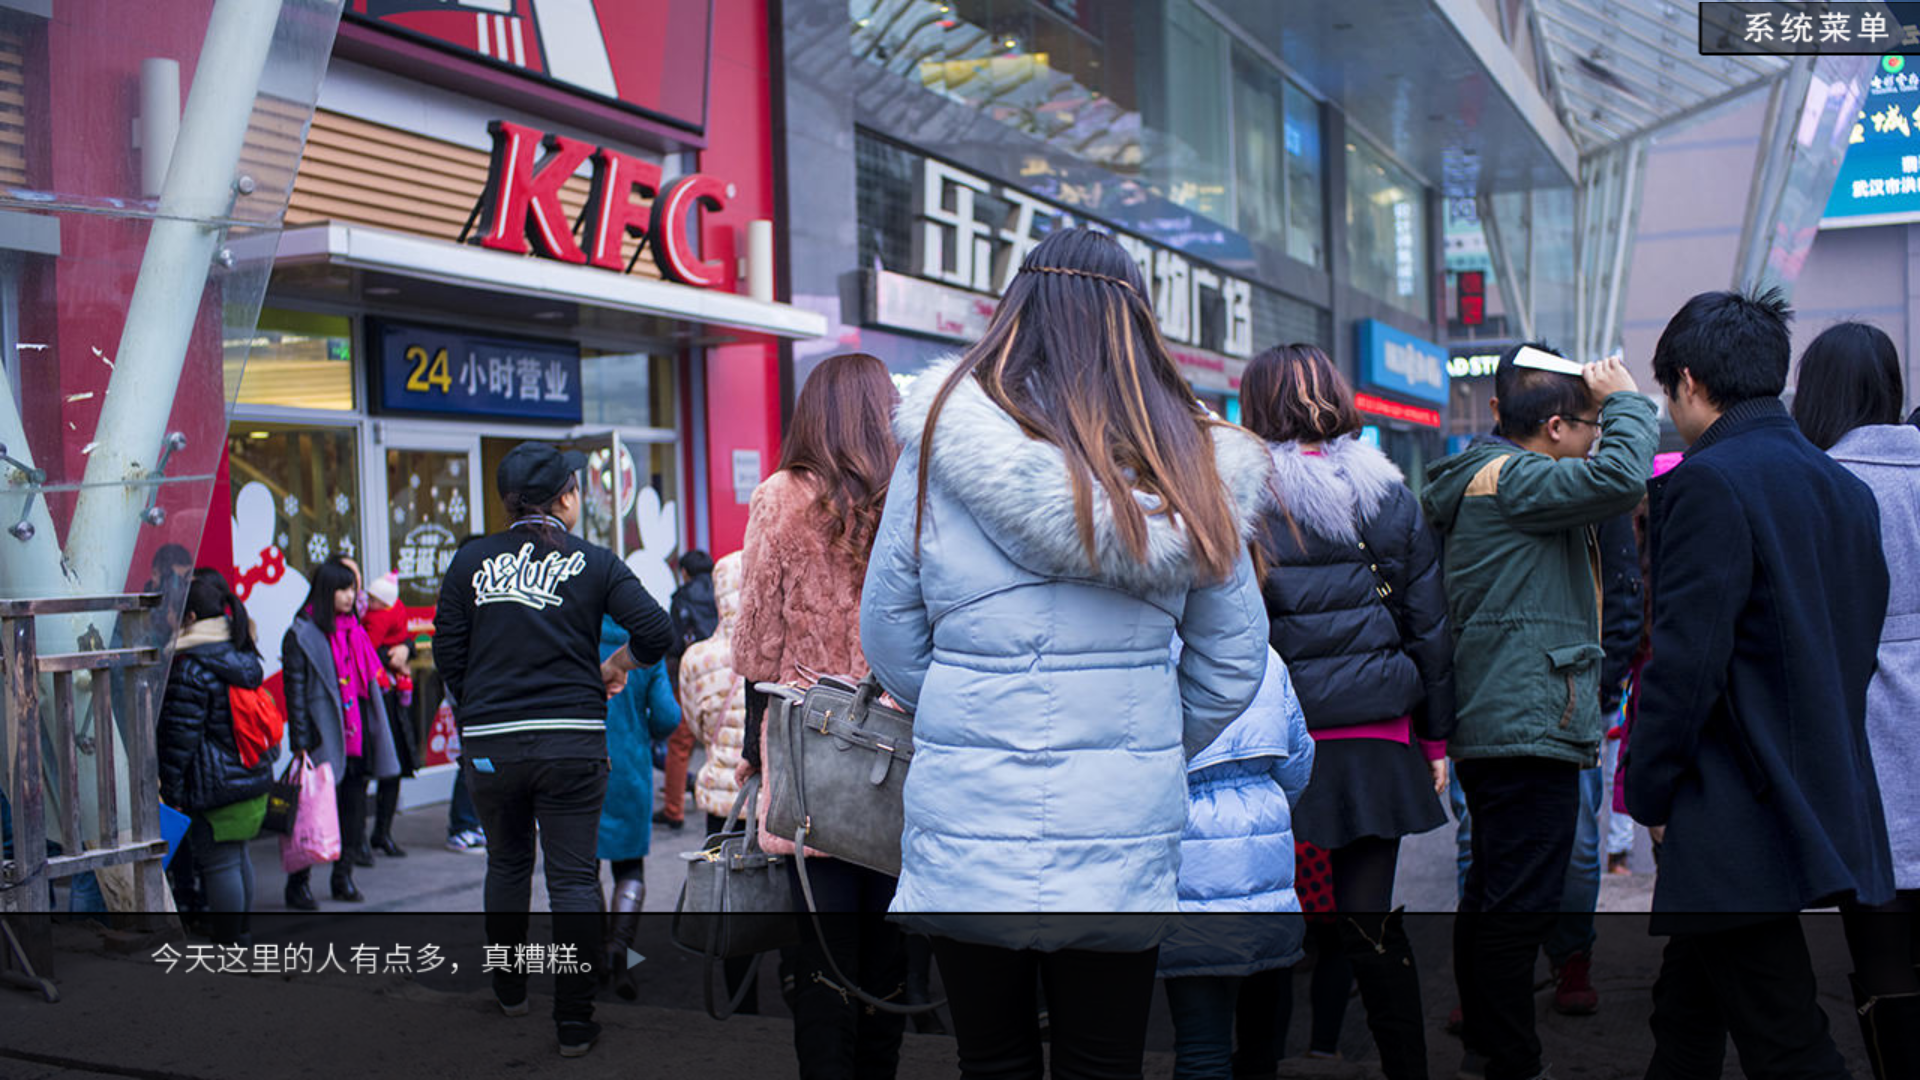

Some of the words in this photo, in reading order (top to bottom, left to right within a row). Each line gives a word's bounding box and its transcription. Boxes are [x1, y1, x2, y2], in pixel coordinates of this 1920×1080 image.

[478, 120, 725, 288] KFC
[923, 157, 1252, 358] 乐天物广场
[1852, 176, 1920, 198] 武汉市洪
